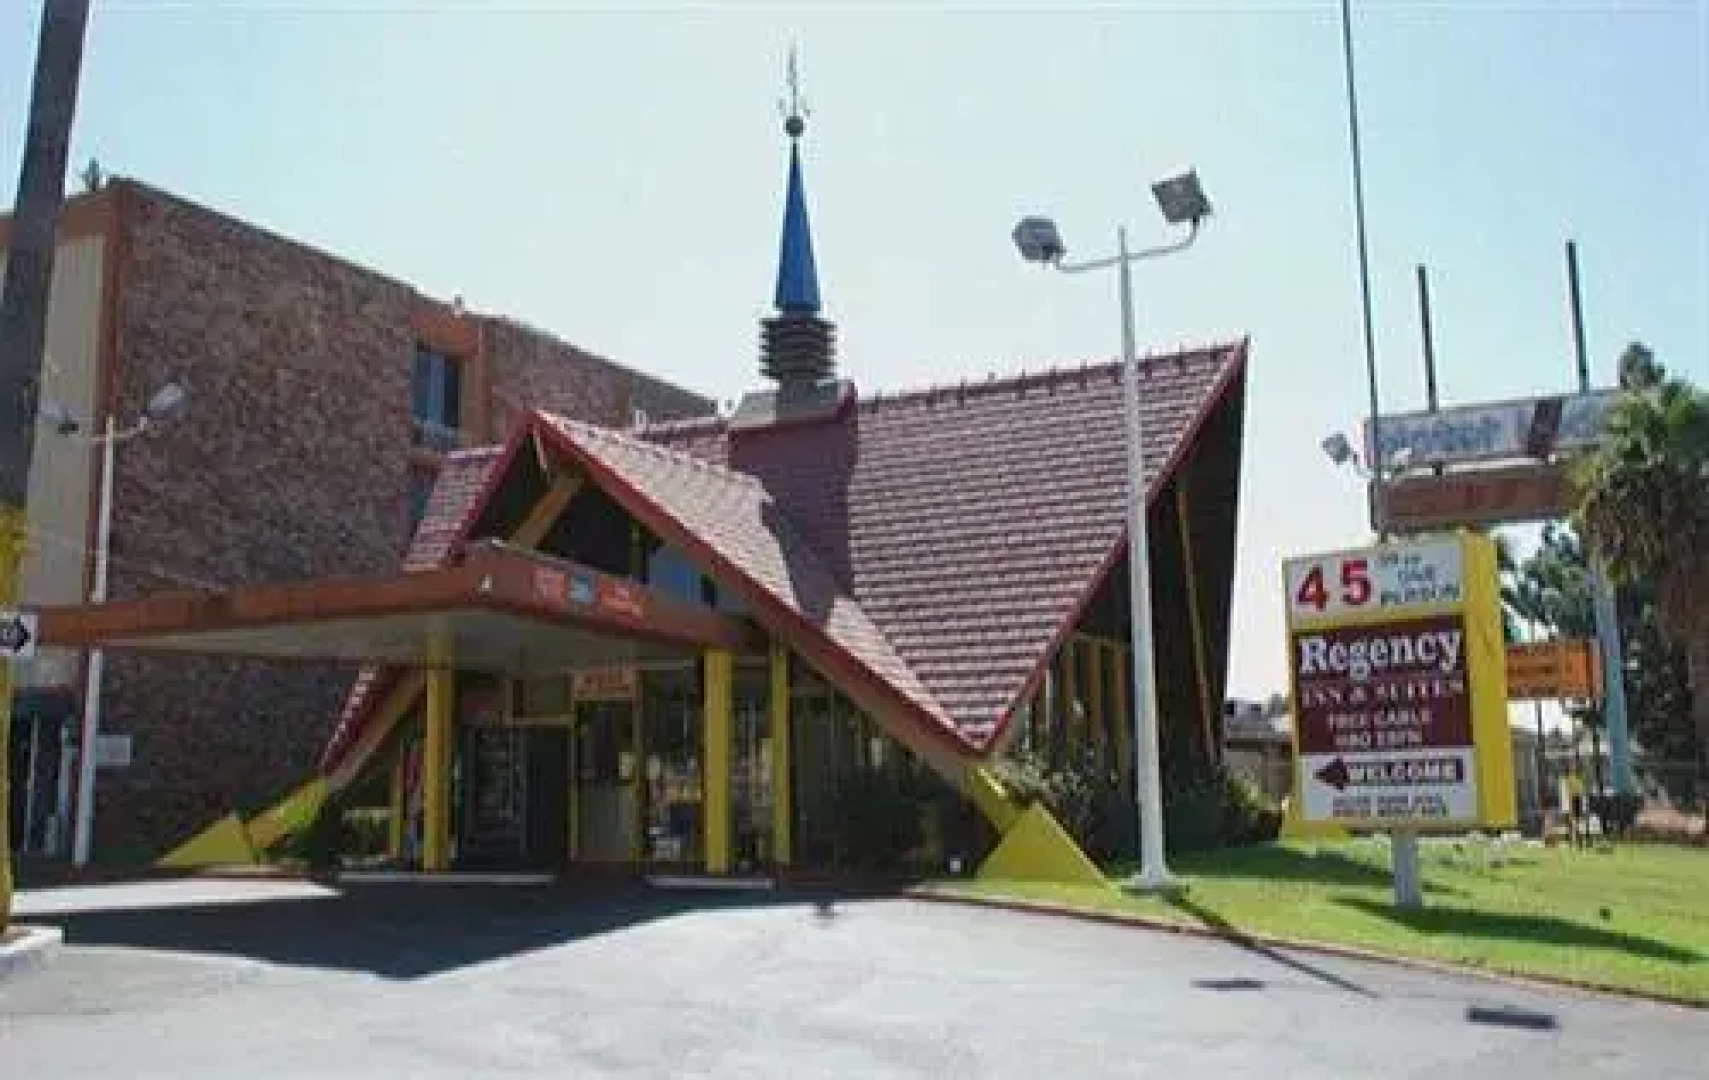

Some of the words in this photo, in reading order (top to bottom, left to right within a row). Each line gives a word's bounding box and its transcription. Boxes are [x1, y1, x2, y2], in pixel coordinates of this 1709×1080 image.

[1300, 630, 1462, 683] Regency
[1301, 687, 1342, 707] INN
[1349, 761, 1457, 783] WELCOME
